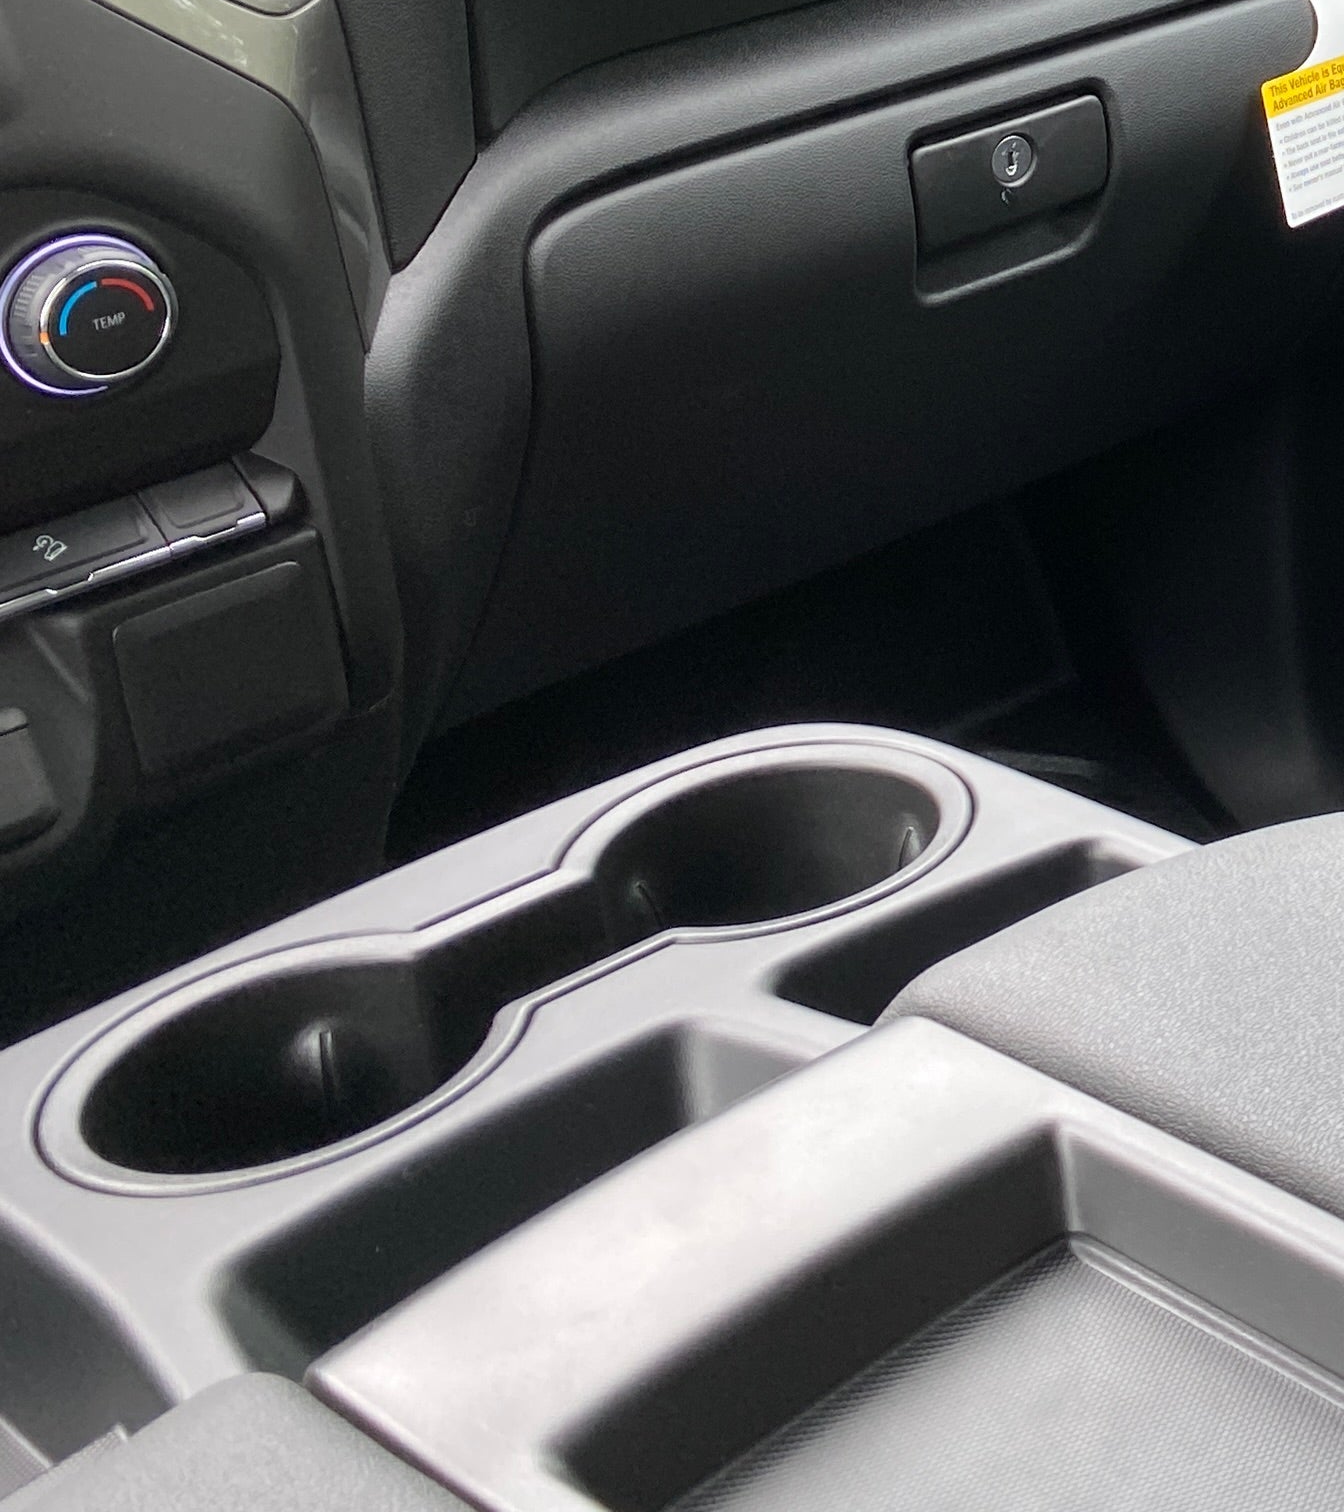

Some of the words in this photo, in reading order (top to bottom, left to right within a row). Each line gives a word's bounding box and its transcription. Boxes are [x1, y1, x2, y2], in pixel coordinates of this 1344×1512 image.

[1269, 83, 1288, 97] This
[1288, 71, 1320, 90] Vehicle
[1321, 68, 1330, 78] is
[1273, 87, 1313, 112] Advanced
[1316, 84, 1327, 96] Air
[92, 311, 126, 331] TEMP
